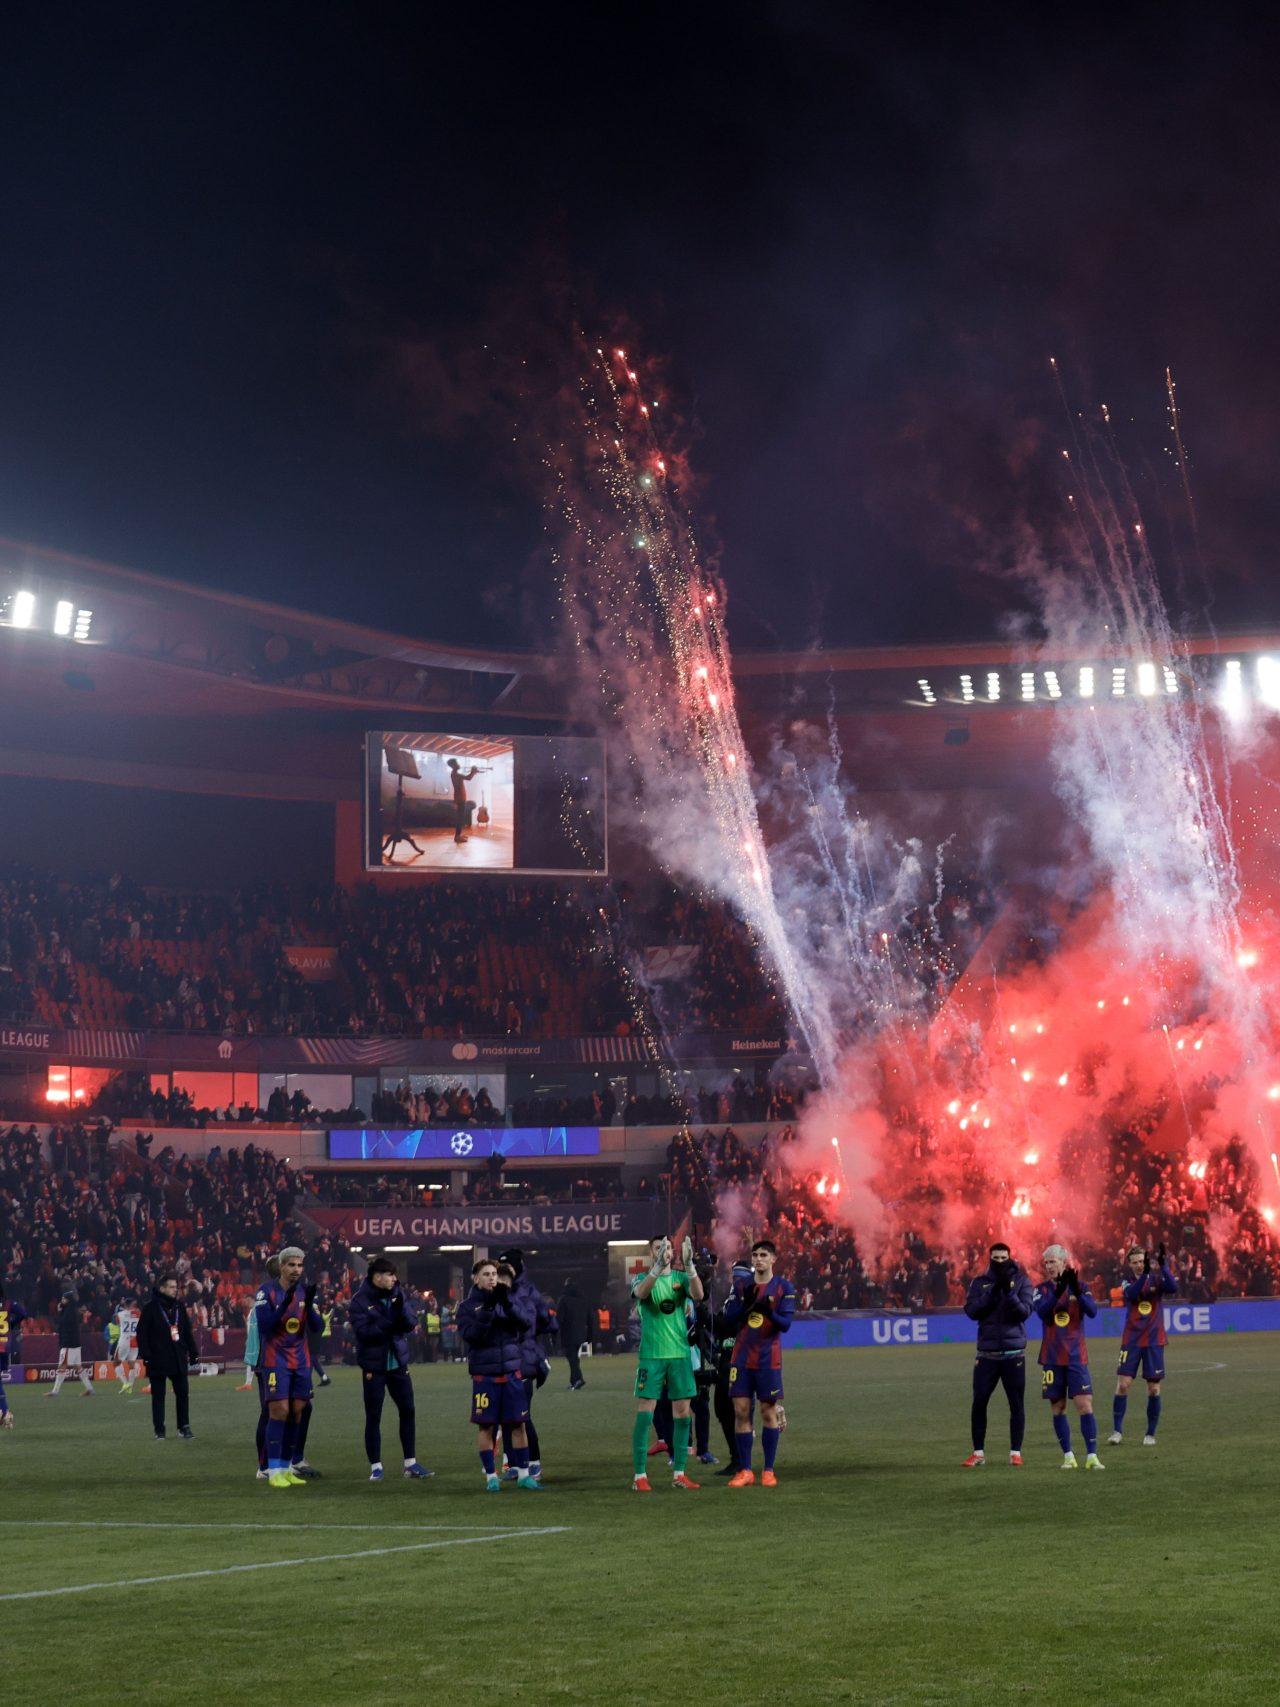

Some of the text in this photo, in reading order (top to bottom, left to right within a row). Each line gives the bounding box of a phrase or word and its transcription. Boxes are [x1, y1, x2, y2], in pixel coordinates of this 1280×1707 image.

[2, 1031, 49, 1048] LEAGUE
[732, 1039, 781, 1050] Heineken
[482, 1046, 541, 1055] mastercard
[354, 1214, 621, 1235] UEFA CHAMPIONS LEAGUE
[123, 1321, 137, 1333] 26
[872, 1318, 928, 1343] UCE
[268, 1372, 277, 1386] 4
[730, 1367, 738, 1382] 8
[475, 1393, 489, 1408] 16
